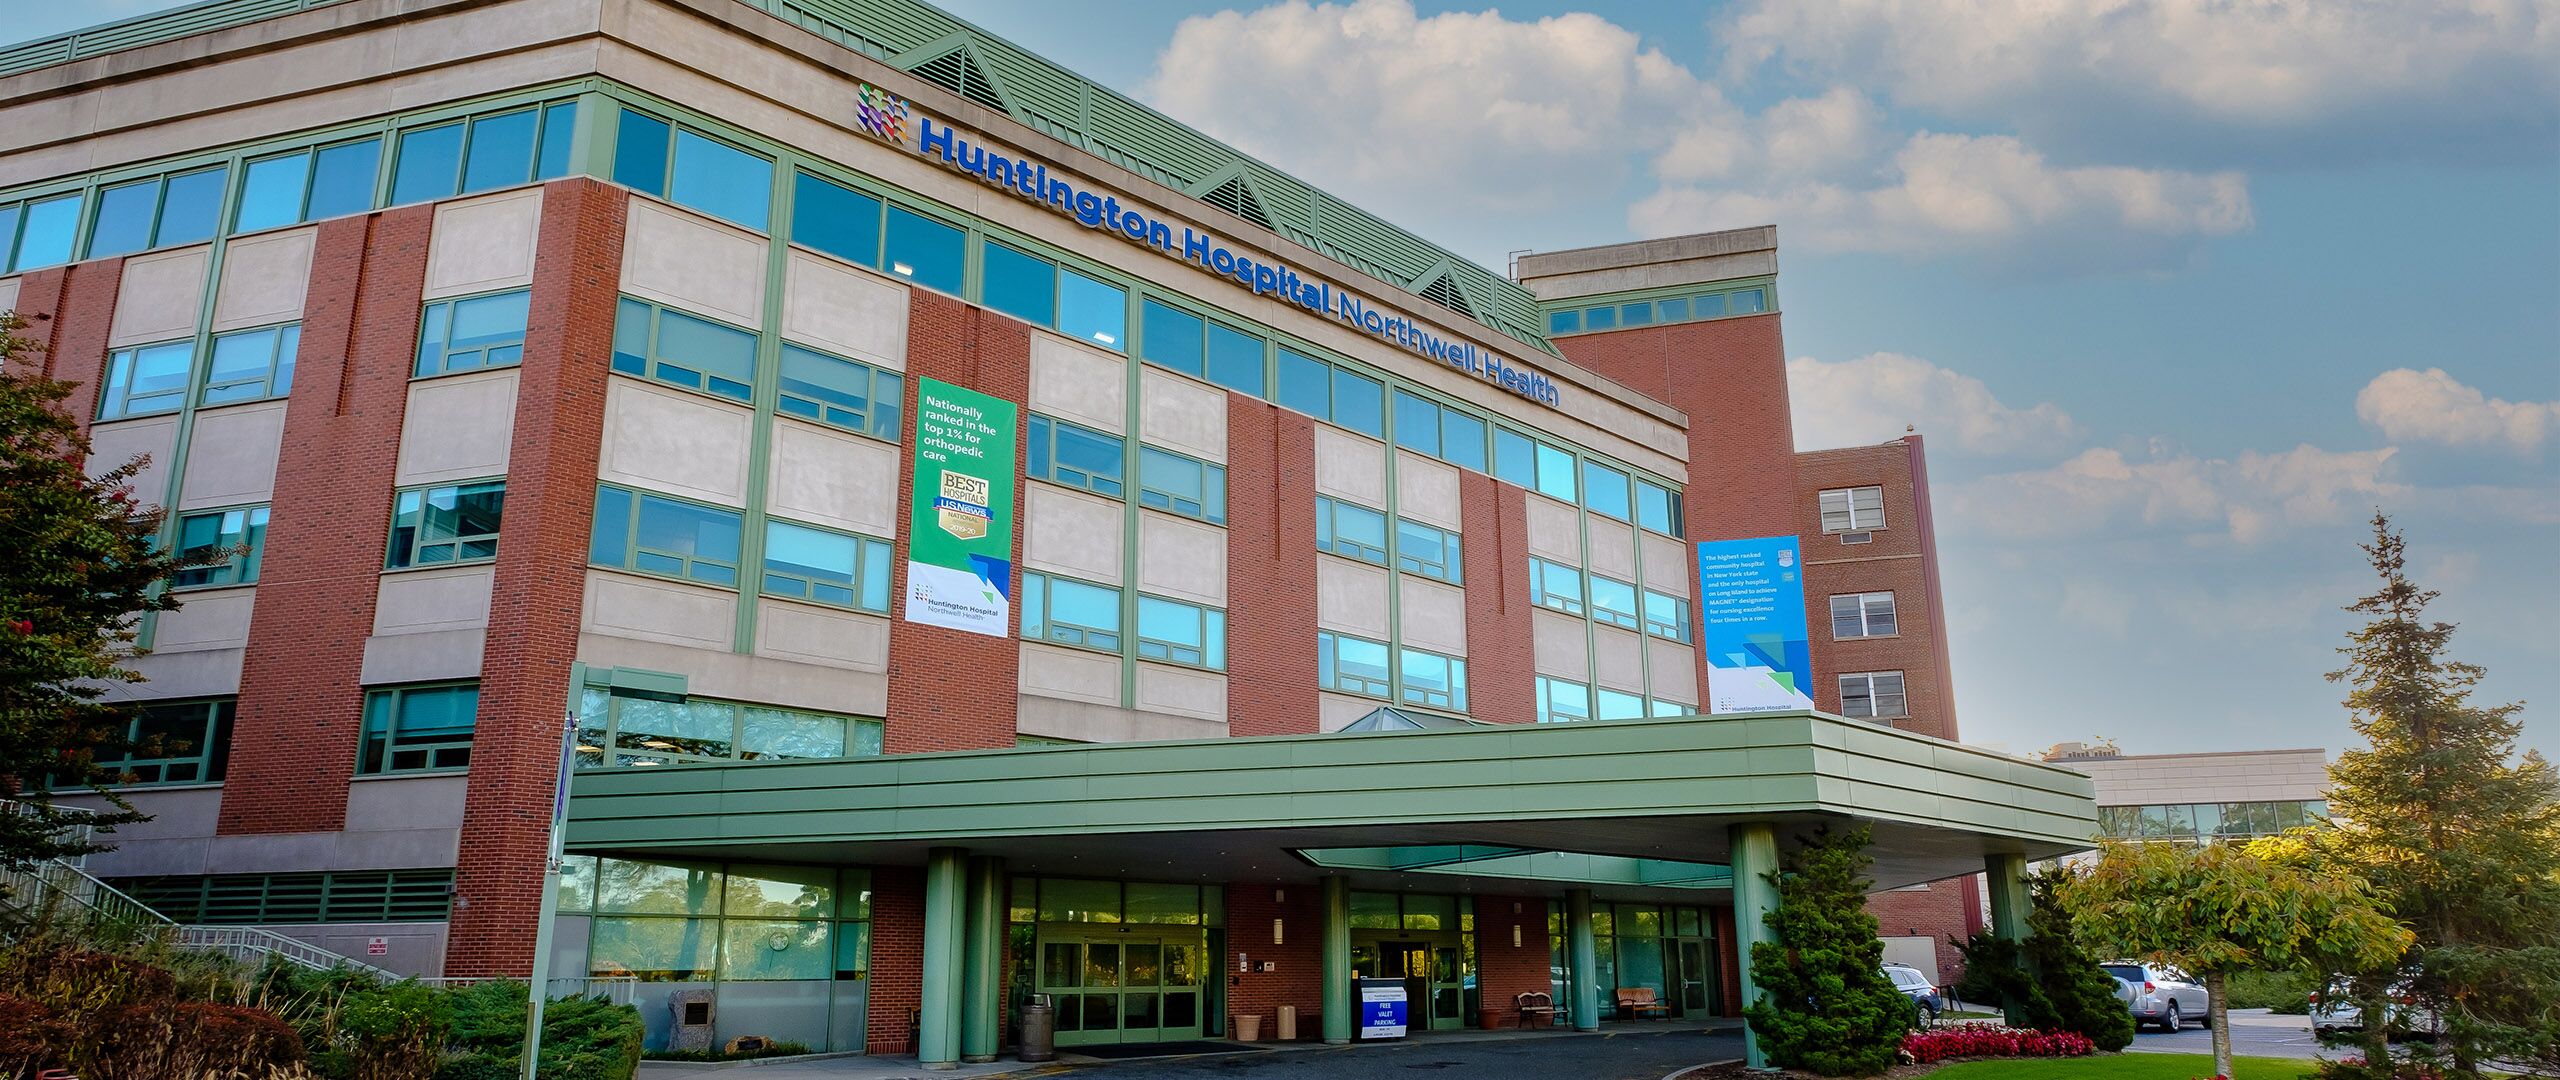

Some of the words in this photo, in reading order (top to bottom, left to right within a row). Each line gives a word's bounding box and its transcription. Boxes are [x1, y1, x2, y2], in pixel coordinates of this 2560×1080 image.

[919, 117, 1172, 251] Huntington
[1183, 226, 1330, 314] Hospital
[1338, 292, 1476, 372] Northwell
[1481, 351, 1560, 407] Health
[926, 395, 983, 421] Nationally
[925, 410, 963, 427] ranked
[966, 419, 976, 430] in
[979, 423, 996, 436] the
[925, 422, 944, 437] top
[946, 428, 963, 440] 1%
[965, 432, 981, 444] for
[923, 450, 947, 463] care
[924, 437, 984, 459] orthopedic
[944, 473, 986, 495] BEST
[943, 487, 986, 506] HOSPITALS
[1740, 552, 1761, 560] ranked
[928, 599, 968, 611] Huntington
[969, 606, 998, 617] Hospital
[928, 606, 961, 617] Northwell
